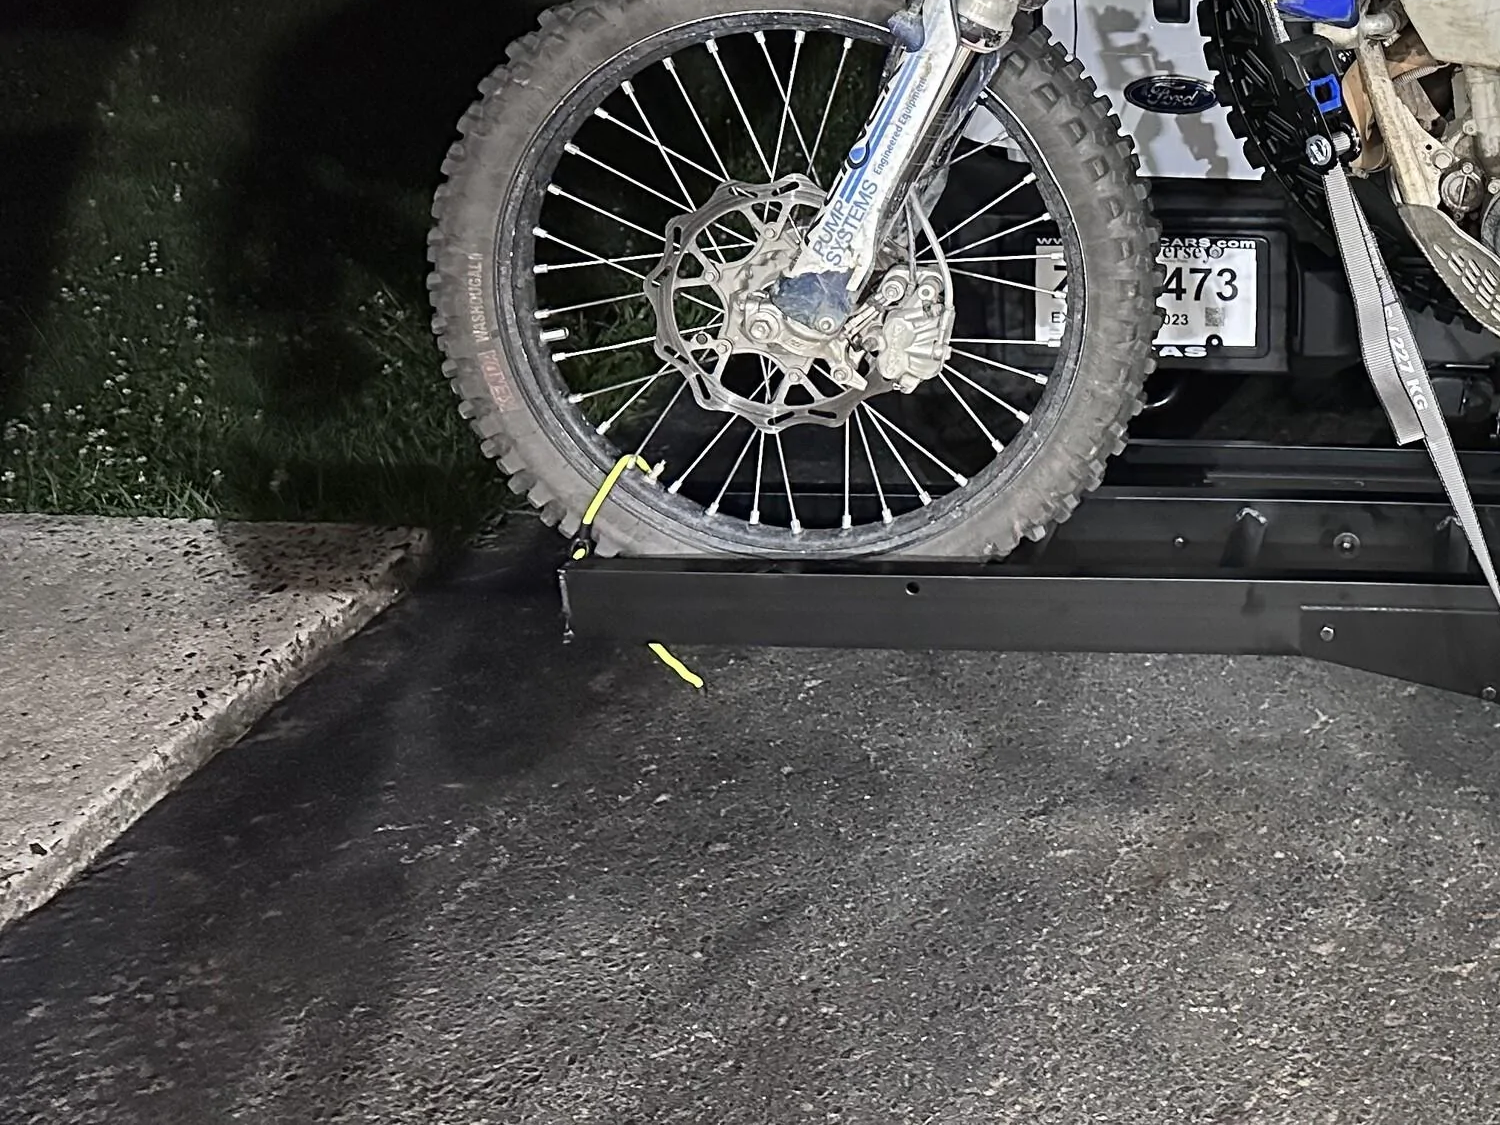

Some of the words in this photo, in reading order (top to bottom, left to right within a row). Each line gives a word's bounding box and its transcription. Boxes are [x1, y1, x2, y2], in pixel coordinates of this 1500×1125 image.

[1146, 82, 1200, 108] Ford
[873, 124, 904, 176] Engineered
[813, 198, 846, 259] PUMP
[827, 179, 878, 266] SYSTEMS
[1406, 378, 1429, 411] KG
